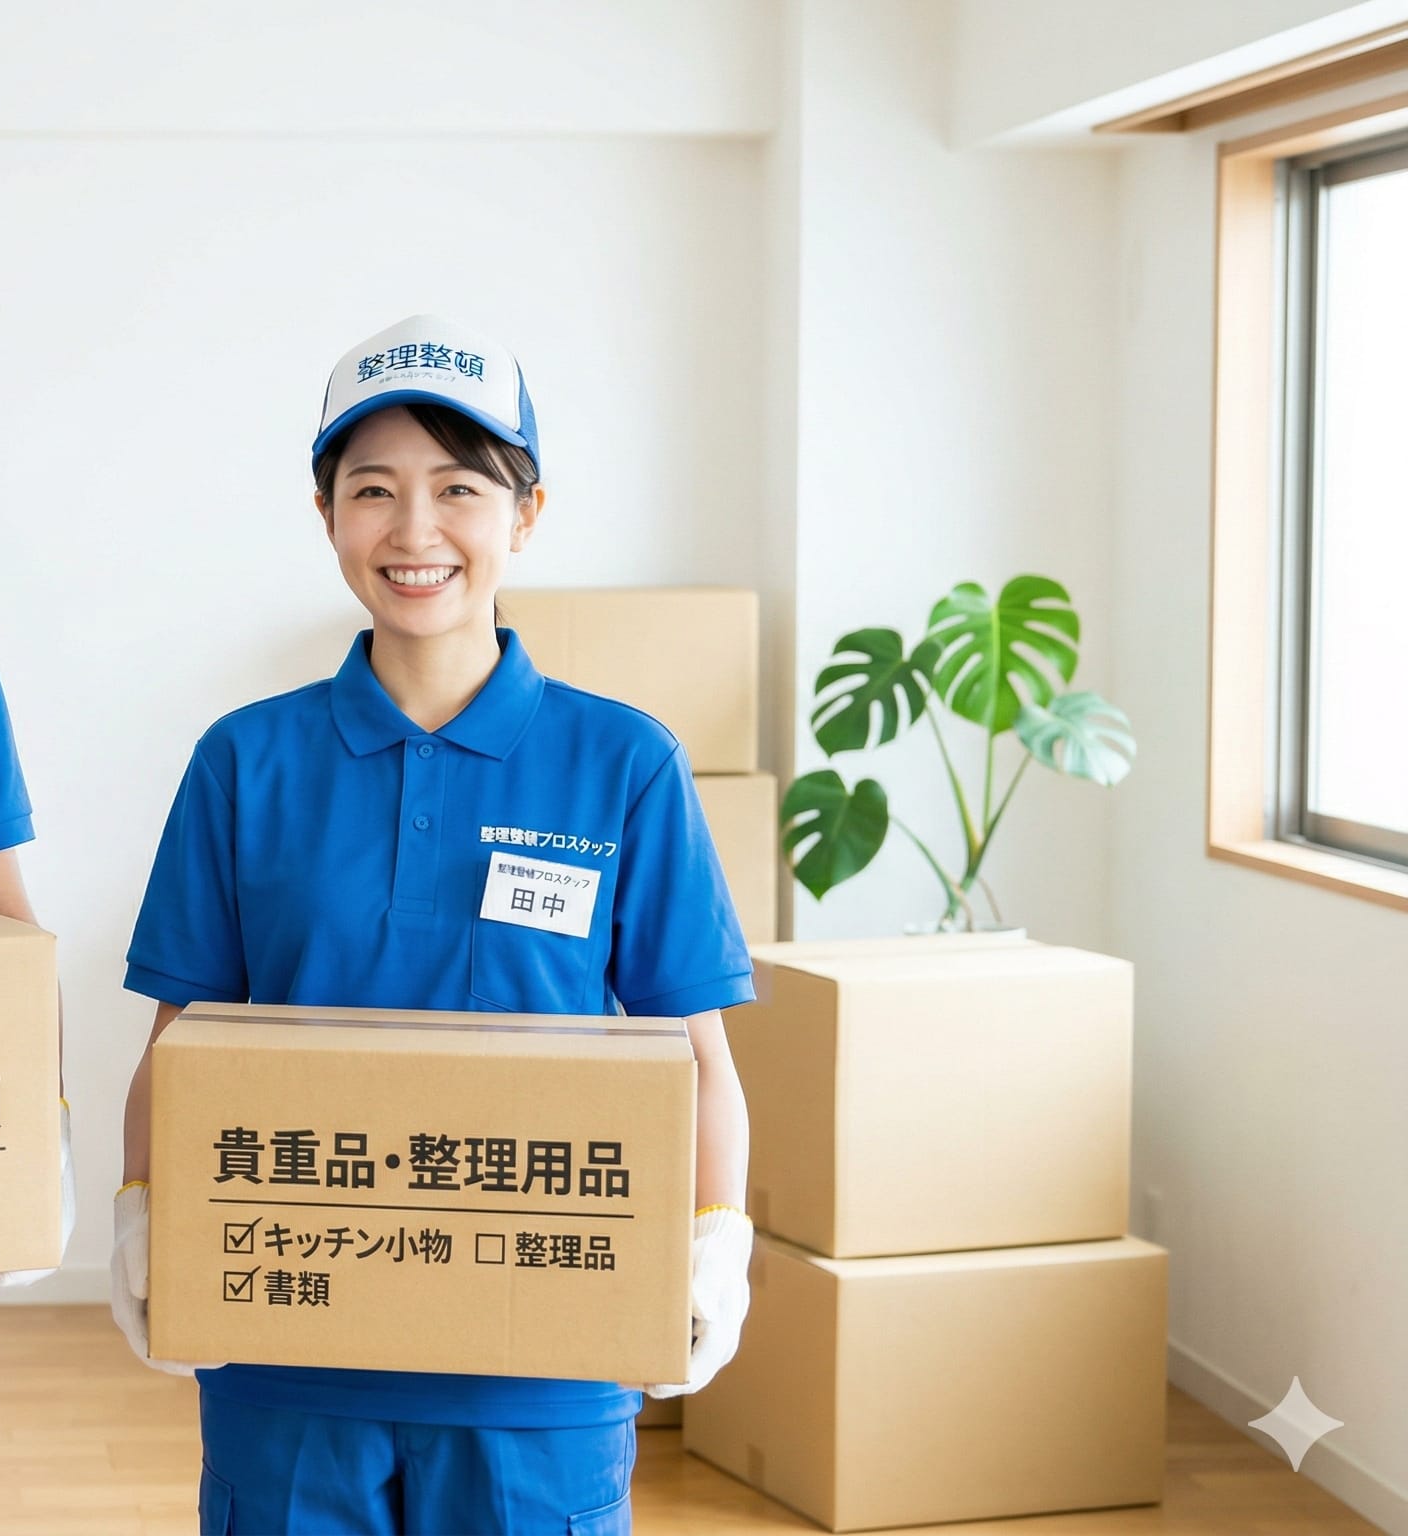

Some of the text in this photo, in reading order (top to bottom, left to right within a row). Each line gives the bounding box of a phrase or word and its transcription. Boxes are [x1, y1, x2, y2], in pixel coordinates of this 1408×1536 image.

[357, 341, 486, 384] 整理整頓
[510, 887, 565, 918] 田中
[213, 1127, 630, 1197] 貴重品・整理用品
[264, 1223, 615, 1270] キッチン小物 整理品
[264, 1270, 330, 1307] 書類
